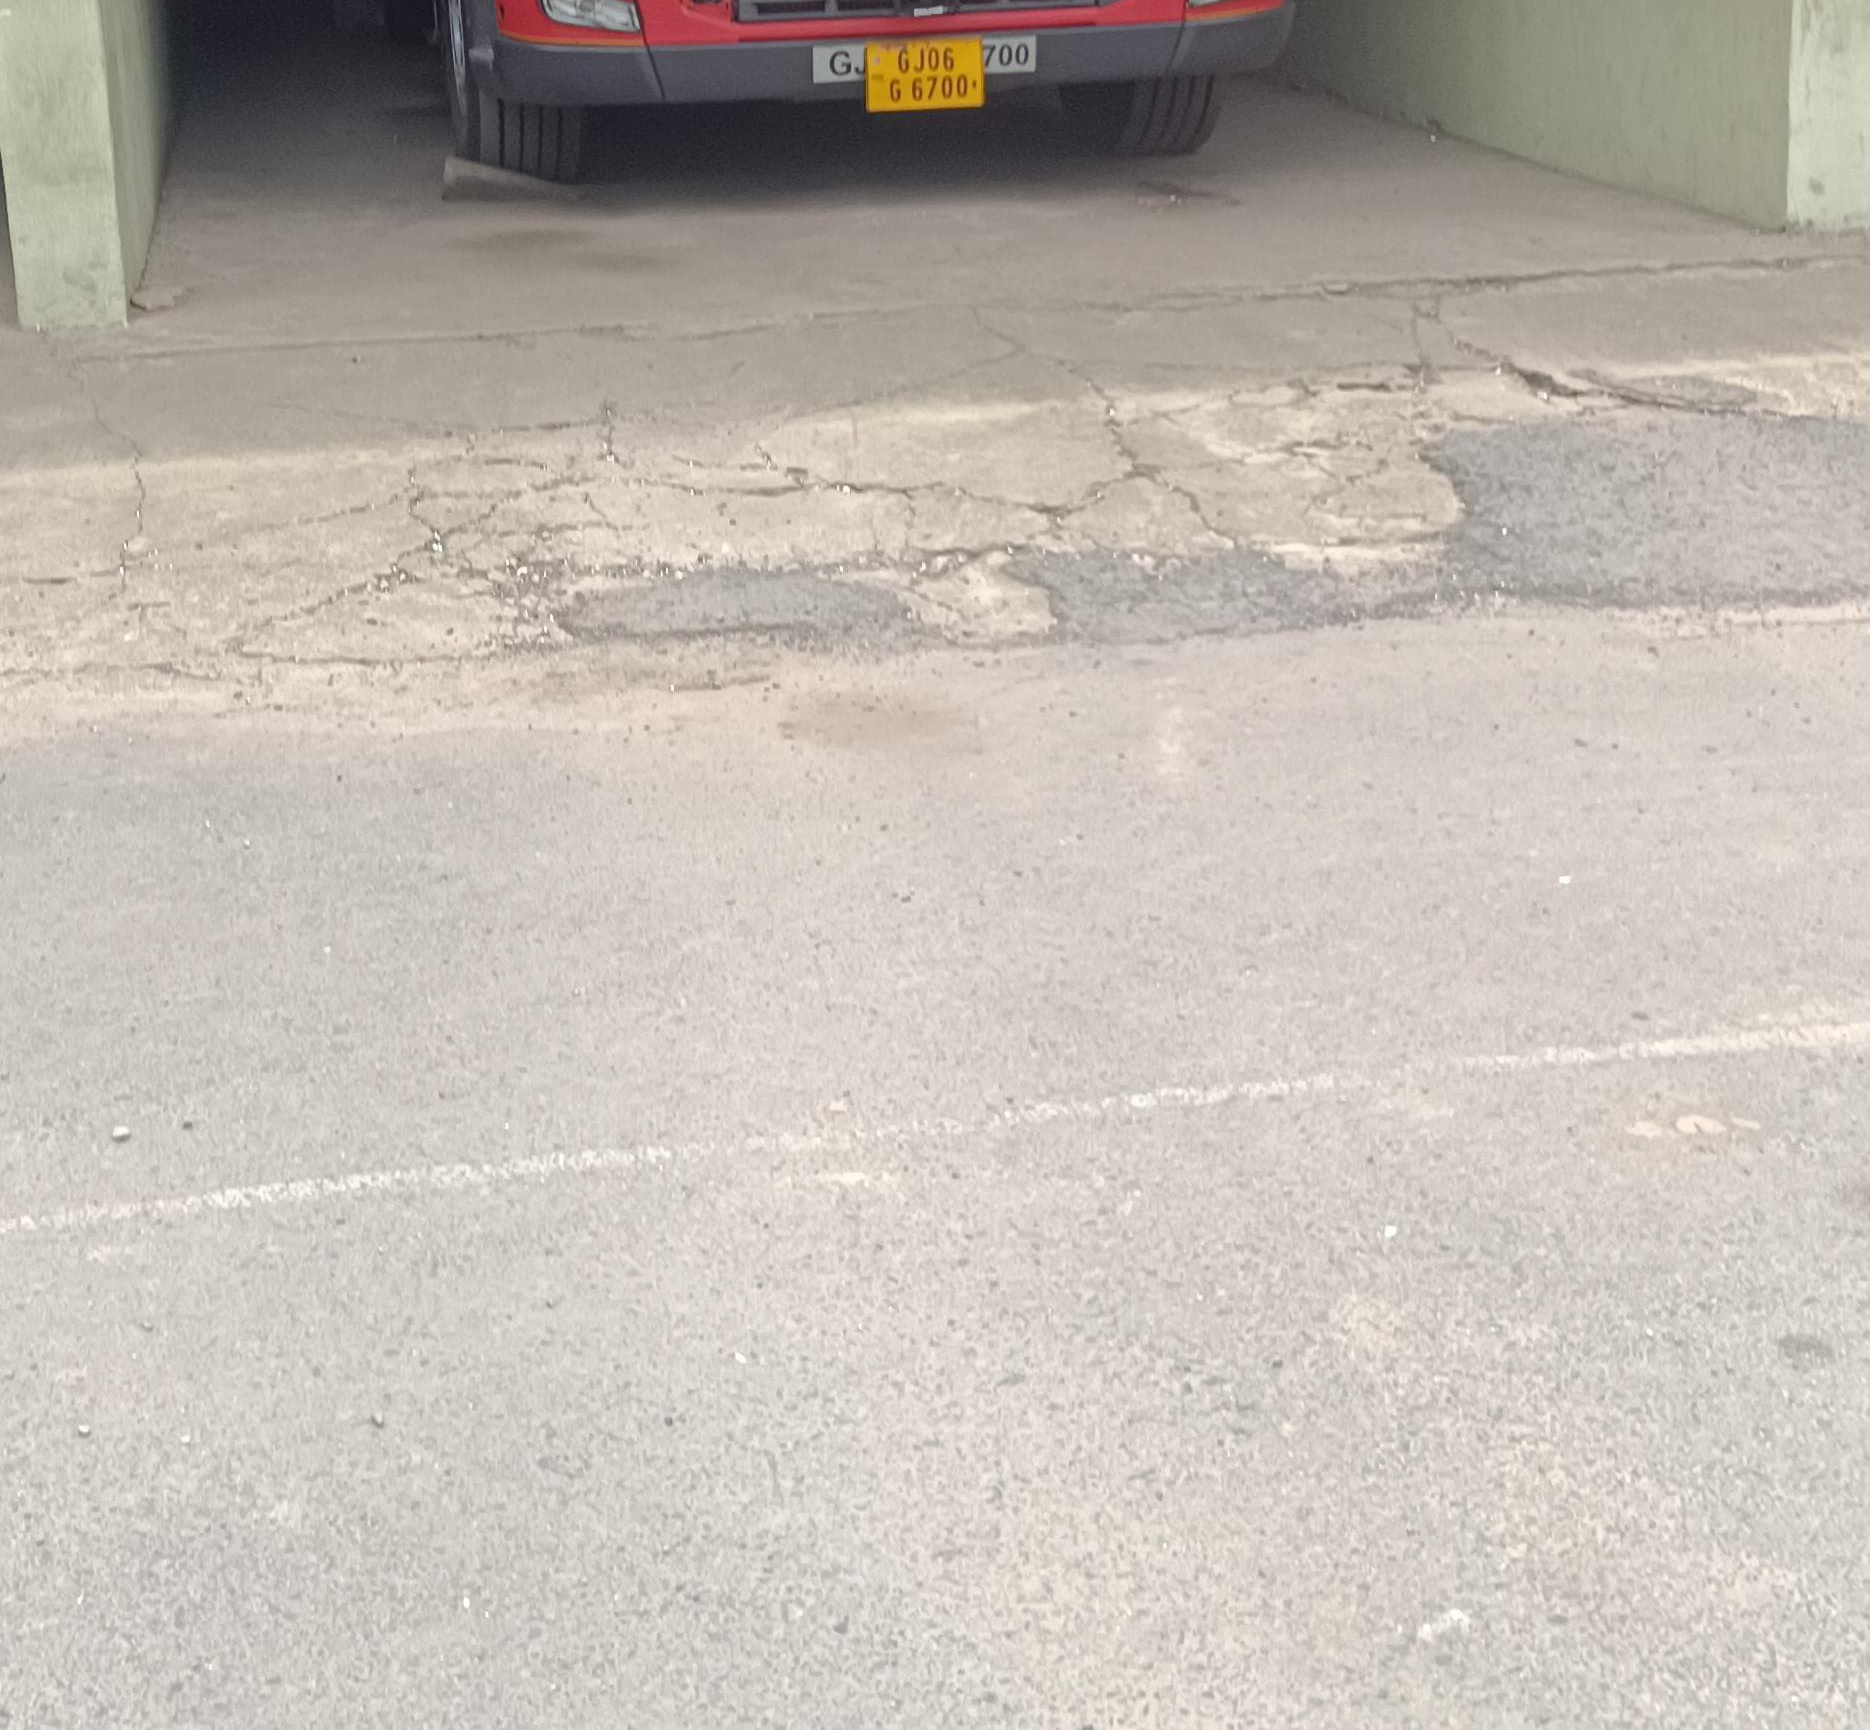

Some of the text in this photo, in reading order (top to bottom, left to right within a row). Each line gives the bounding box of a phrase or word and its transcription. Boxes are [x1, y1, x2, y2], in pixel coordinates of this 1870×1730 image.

[897, 47, 954, 74] GJ06
[889, 74, 968, 102] G 6700
